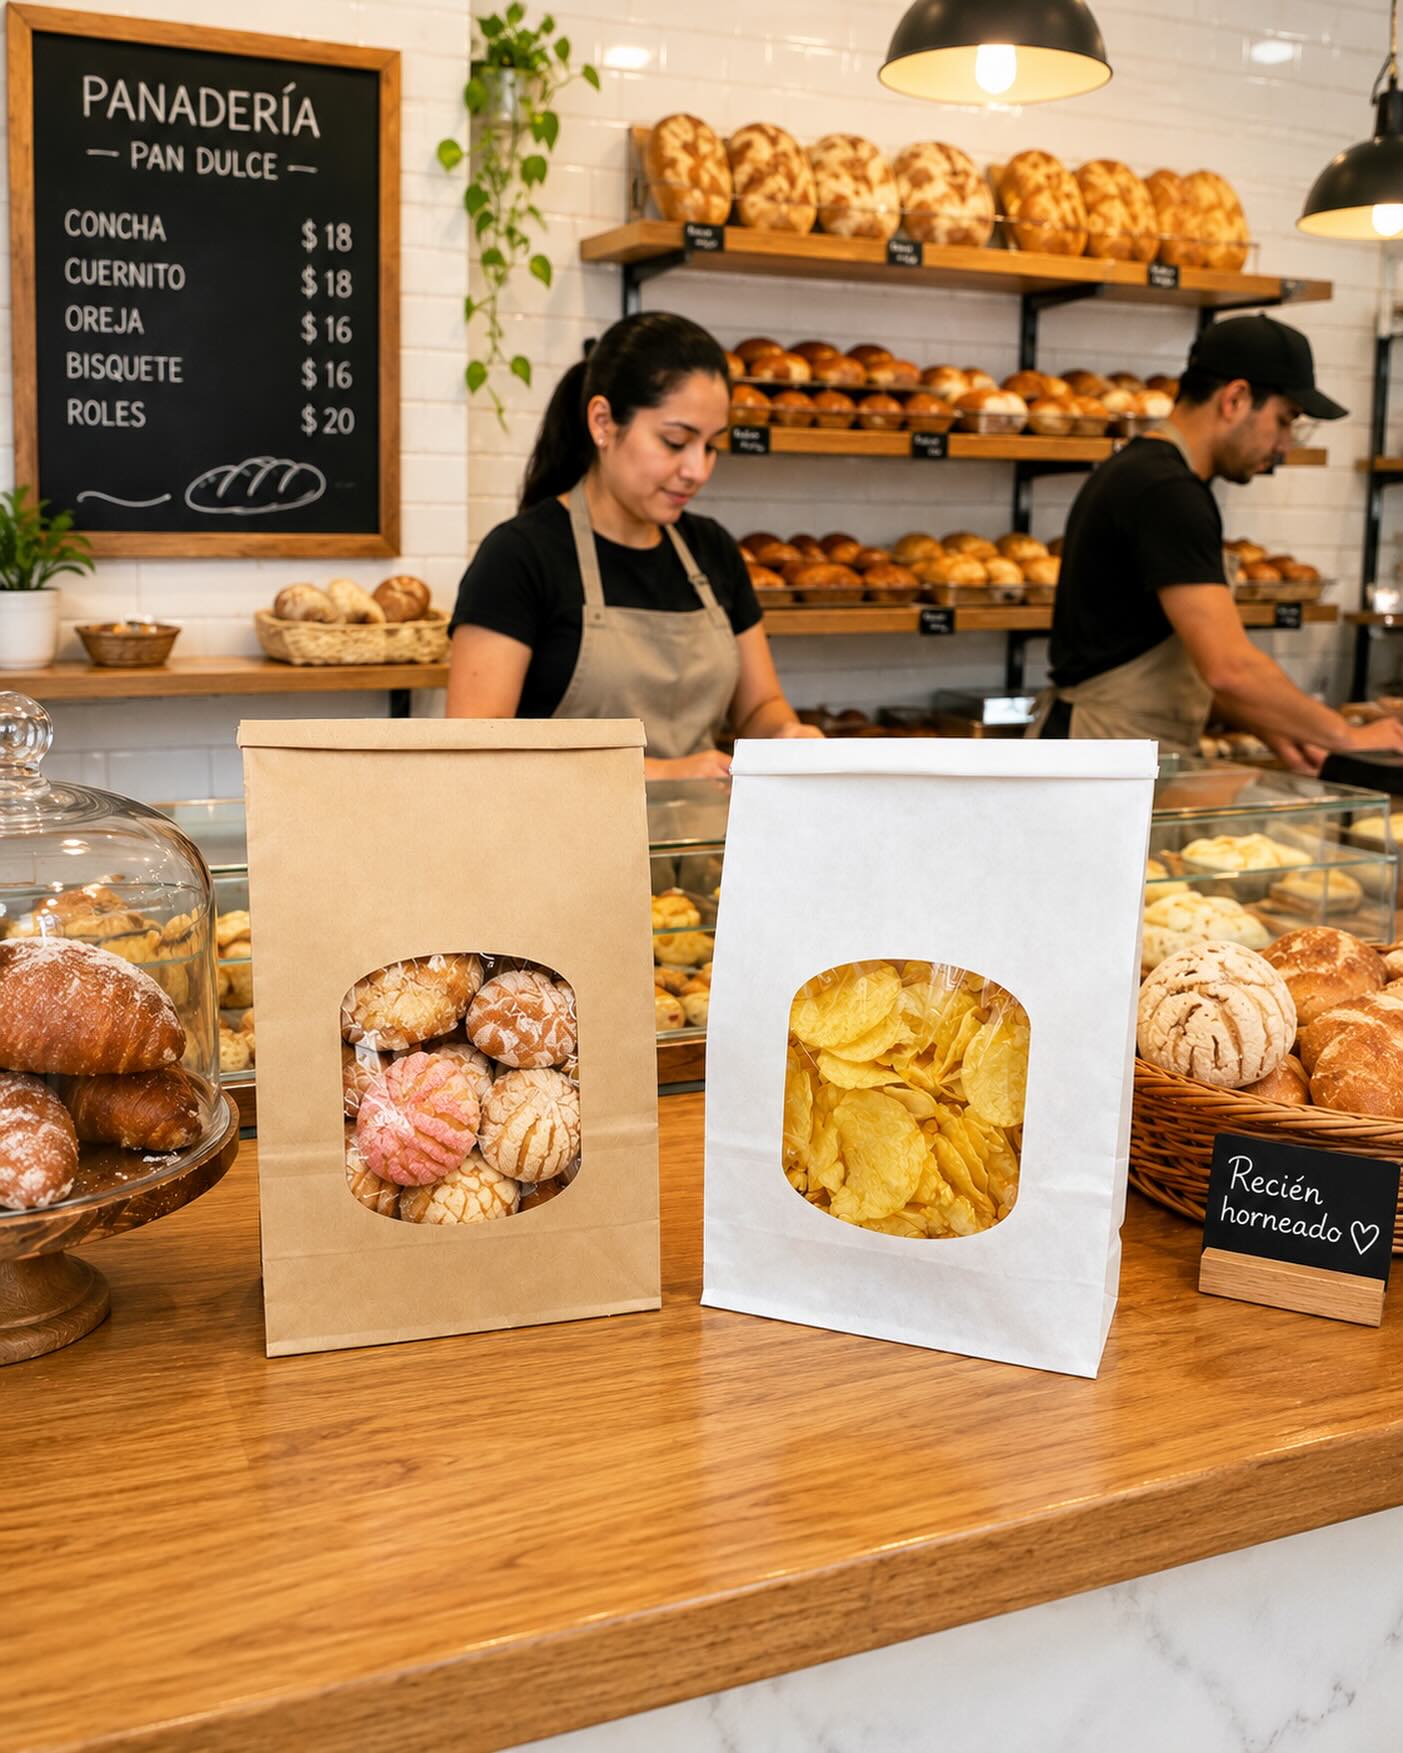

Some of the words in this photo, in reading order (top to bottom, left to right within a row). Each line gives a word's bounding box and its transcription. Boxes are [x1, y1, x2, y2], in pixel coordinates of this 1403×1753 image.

[82, 75, 321, 138] PANADERÍA
[130, 140, 185, 172] PAN
[196, 146, 279, 181] DULCE
[64, 208, 167, 242] CONCHA
[64, 257, 186, 291] CUERNITO
[64, 304, 145, 335] OREJA
[66, 351, 183, 383] BISQUETE
[67, 398, 147, 428] ROLES
[1228, 1154, 1324, 1205] Recién
[1220, 1195, 1343, 1243] horneado
